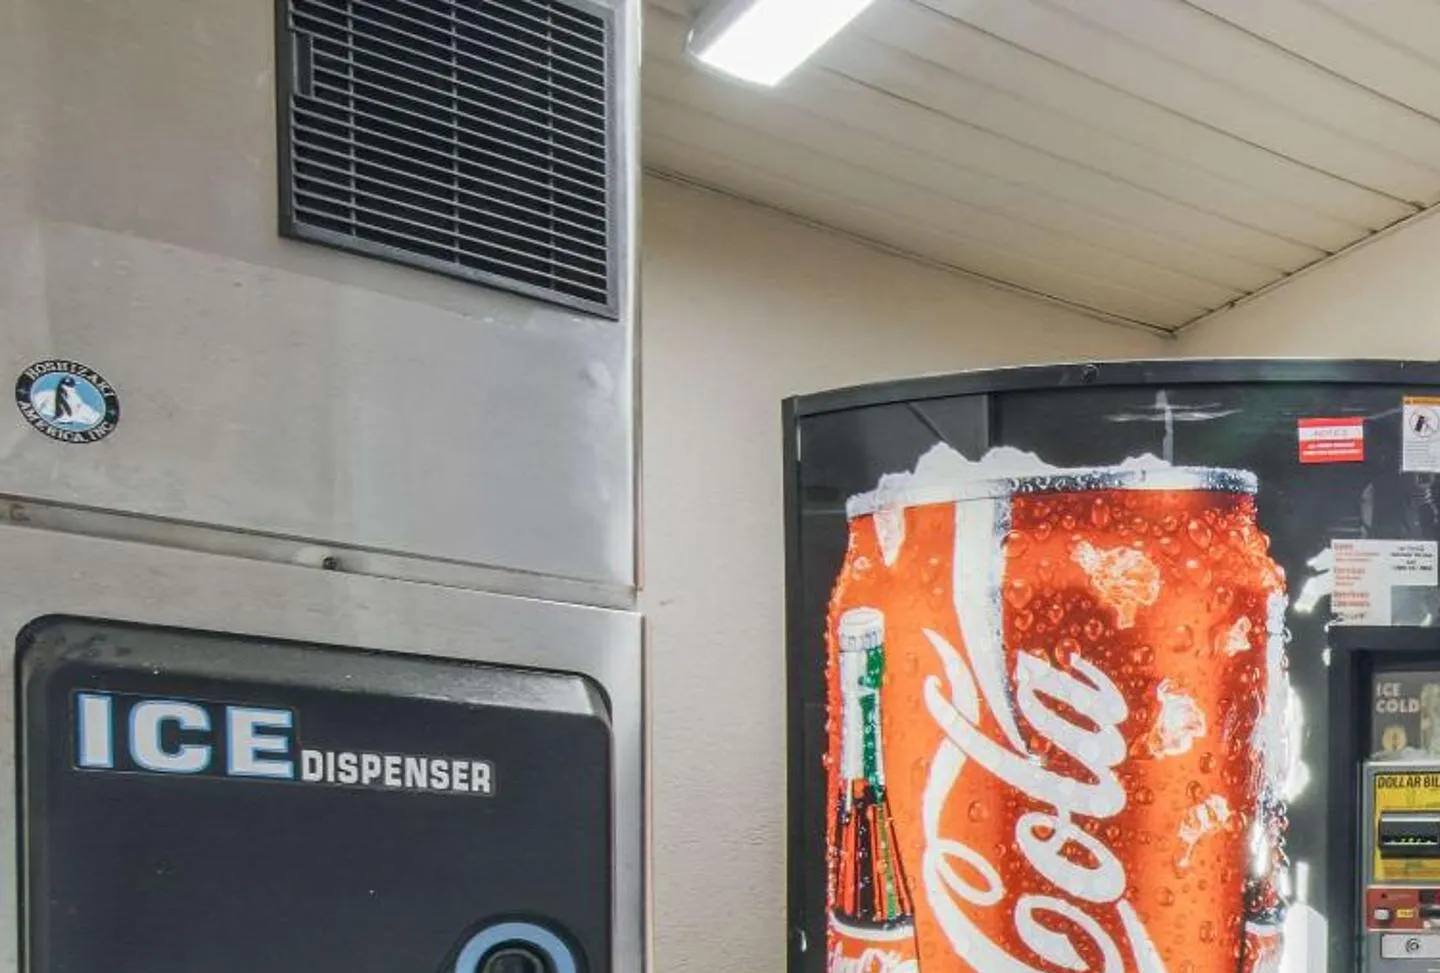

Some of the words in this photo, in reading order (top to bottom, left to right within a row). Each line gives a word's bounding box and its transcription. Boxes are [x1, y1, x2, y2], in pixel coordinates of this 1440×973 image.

[1376, 682, 1400, 697] ICE
[1376, 698, 1420, 713] COLD
[76, 691, 296, 778] ICE
[301, 749, 493, 793] DISPENSER
[1377, 776, 1421, 789] DOLLAR
